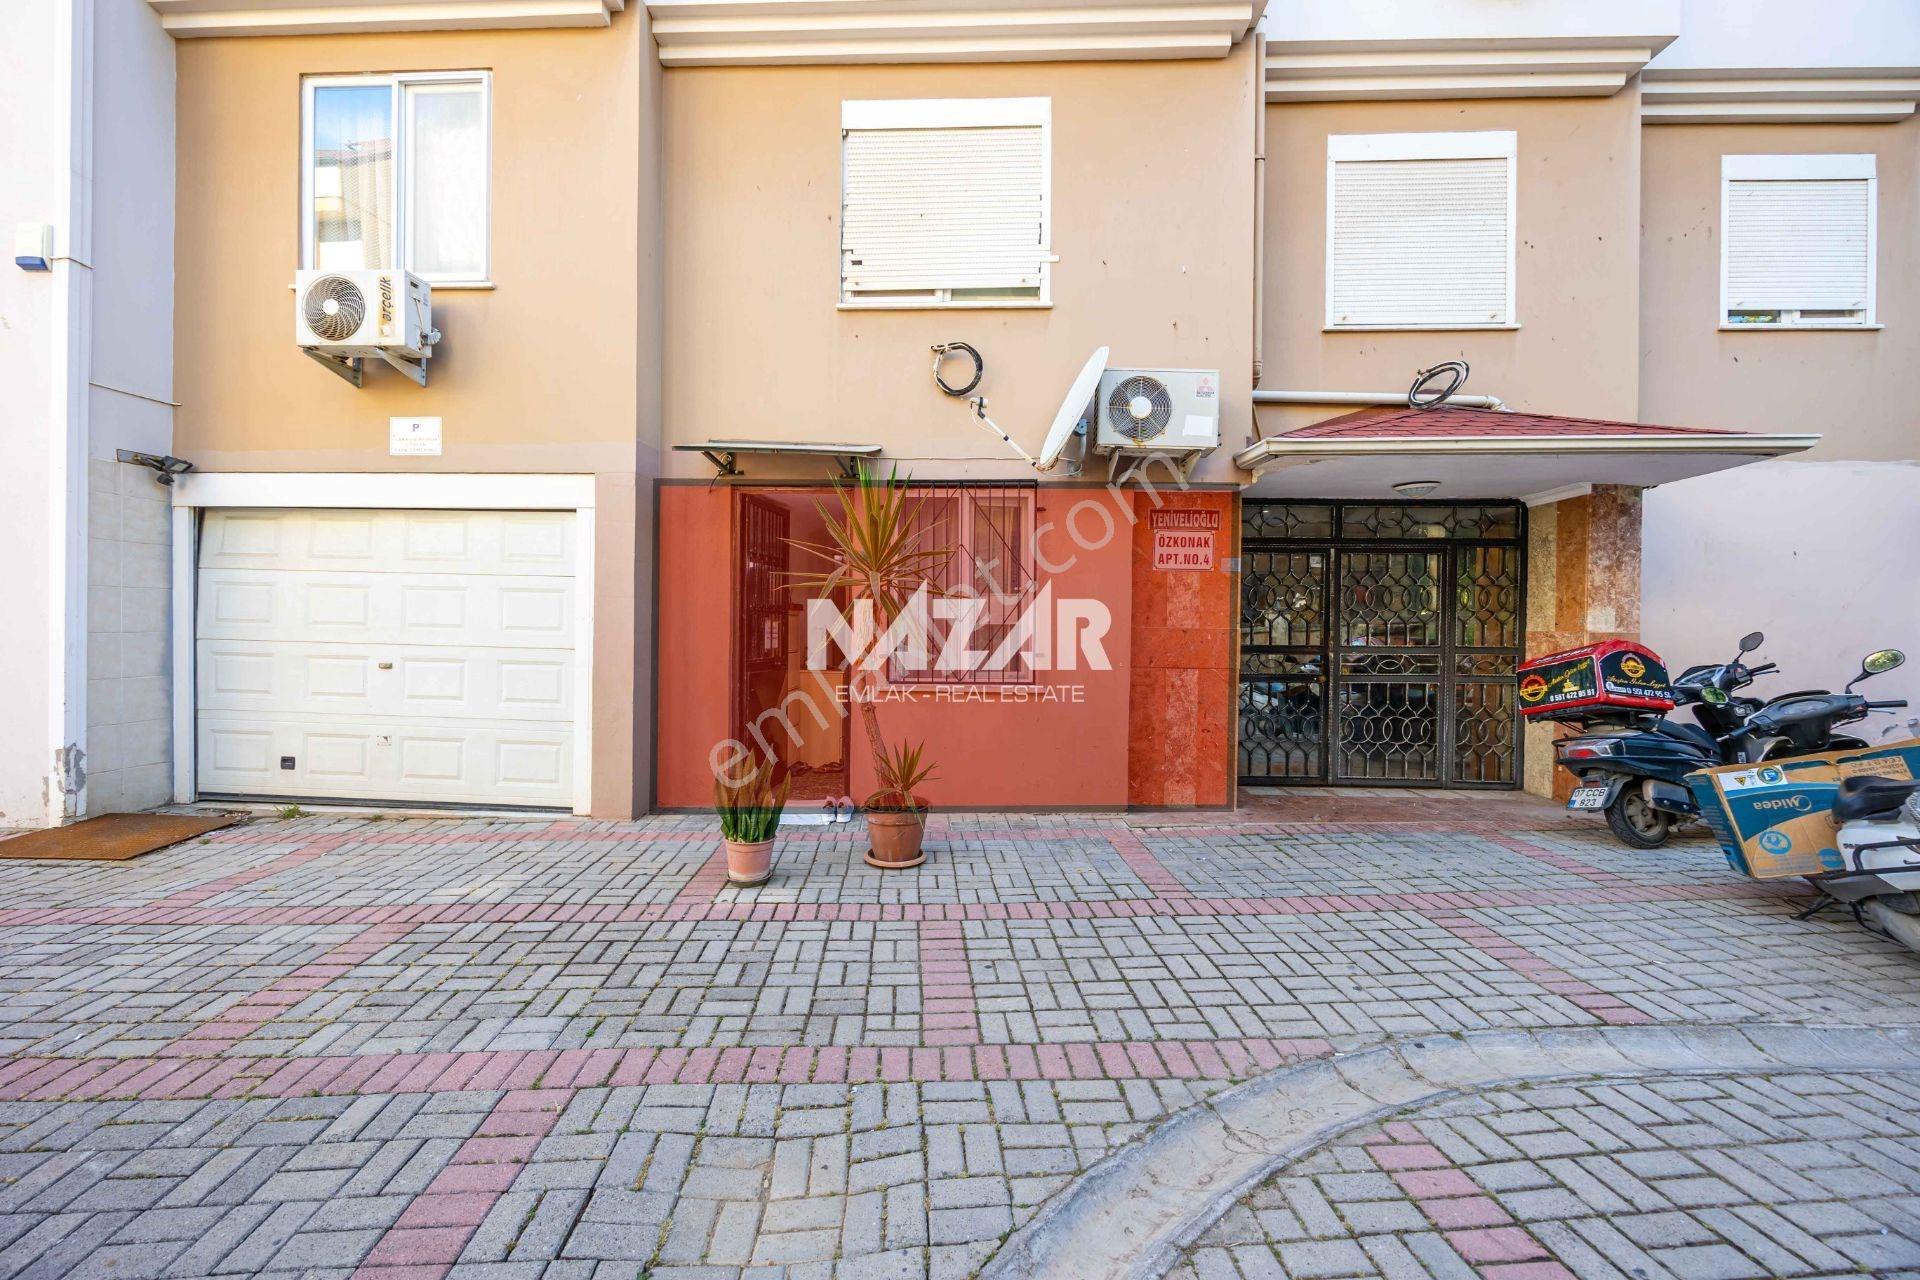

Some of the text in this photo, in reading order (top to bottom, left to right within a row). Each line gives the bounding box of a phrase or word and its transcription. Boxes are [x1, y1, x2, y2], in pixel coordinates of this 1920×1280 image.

[380, 277, 394, 322] arçelik
[412, 423, 420, 432] P
[1152, 510, 1218, 528] YENİVELİOĞLU
[1158, 534, 1210, 548] ÖZKONAK
[1158, 553, 1210, 565] APT.NO.4
[1574, 789, 1606, 798] 07 CCB
[1753, 796, 1802, 810] Midea
